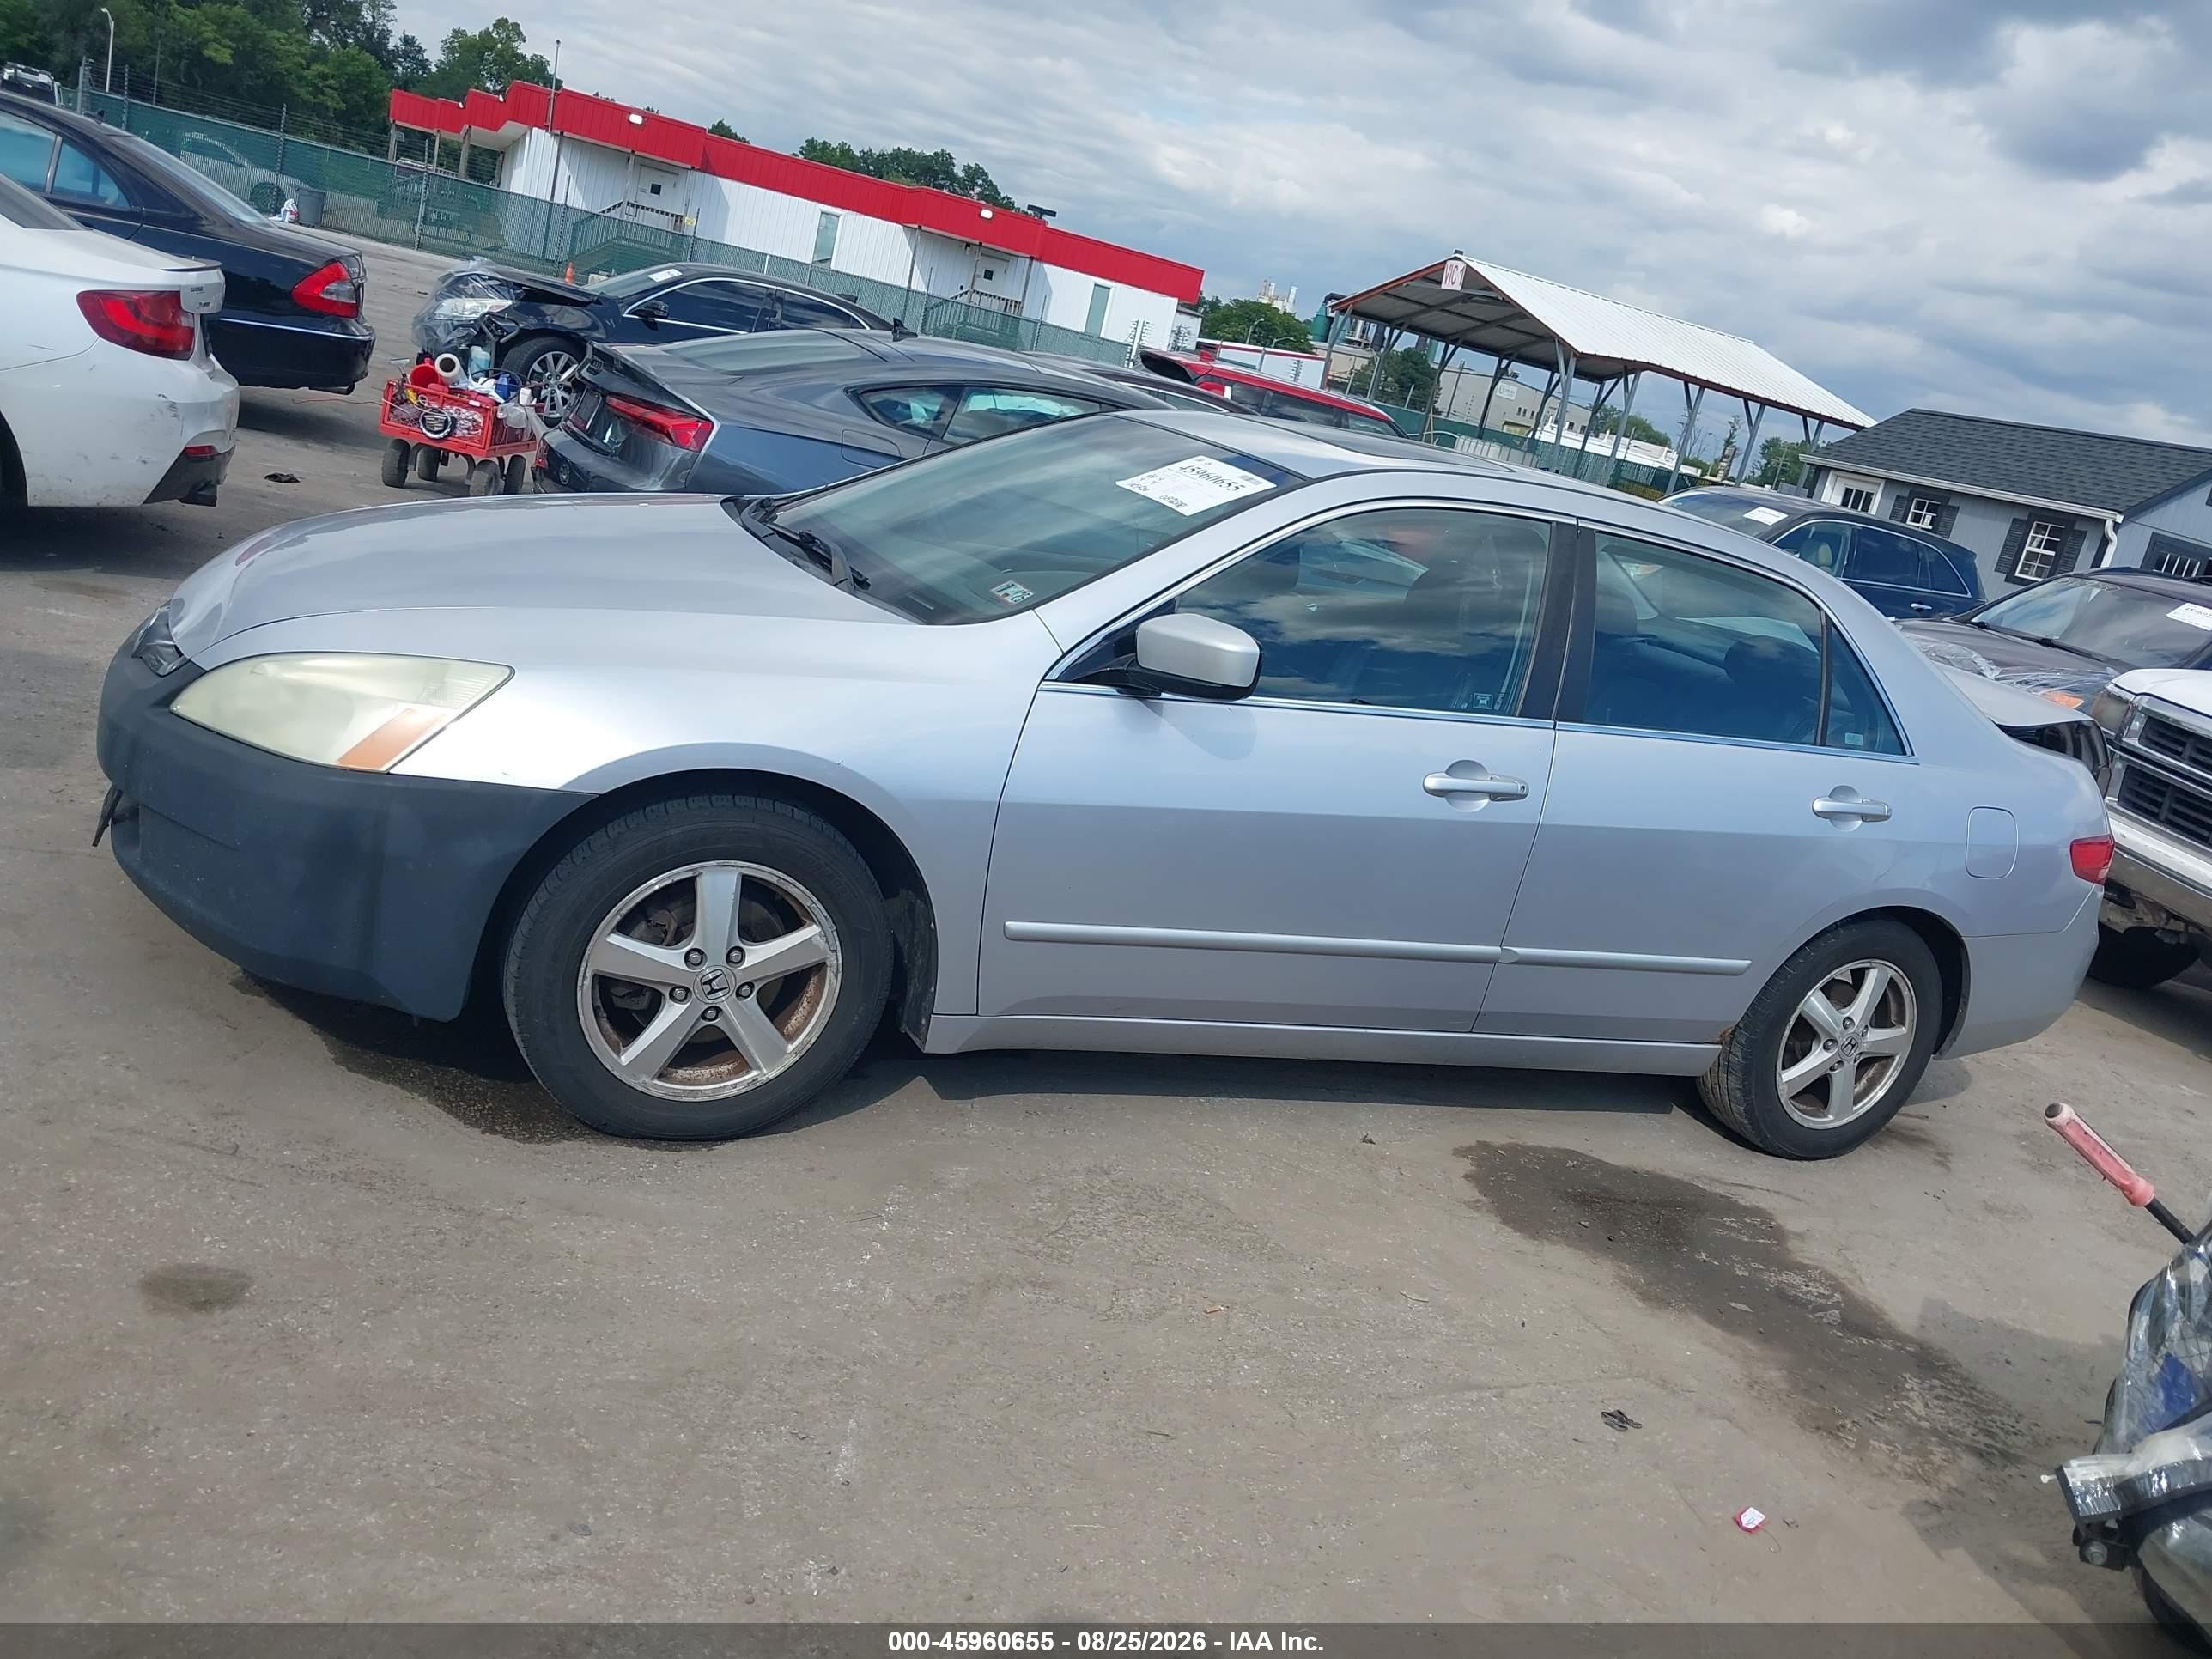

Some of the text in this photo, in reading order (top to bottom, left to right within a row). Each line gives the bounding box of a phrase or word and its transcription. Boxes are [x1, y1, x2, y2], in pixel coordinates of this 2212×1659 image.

[1443, 264, 1466, 286] VIC 1
[1178, 464, 1247, 492] 45960655
